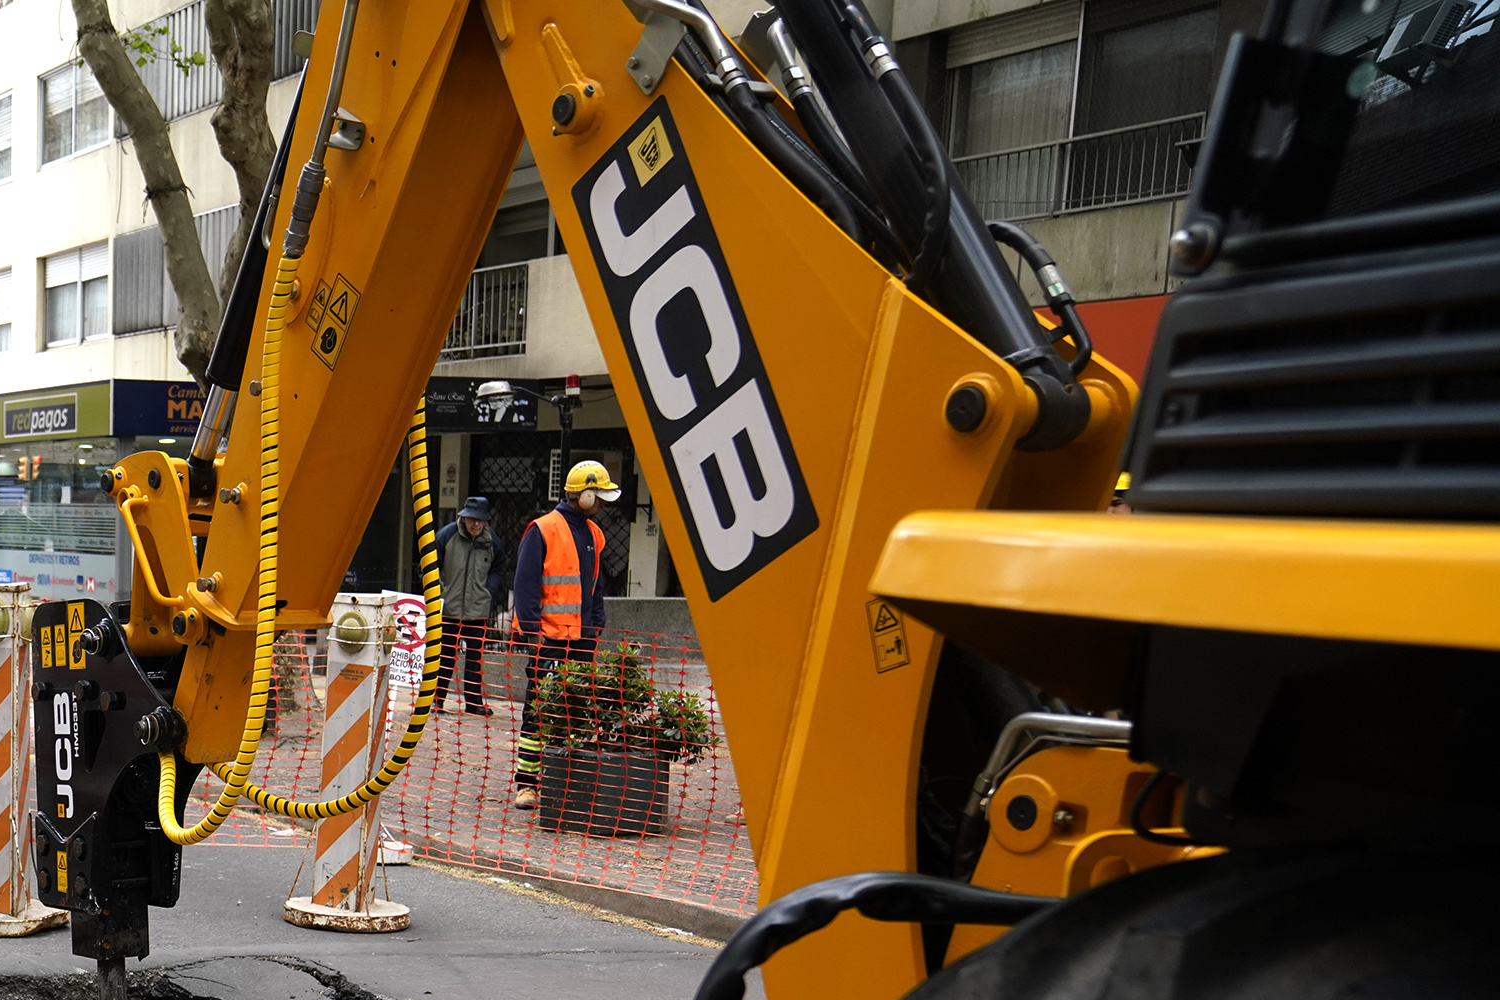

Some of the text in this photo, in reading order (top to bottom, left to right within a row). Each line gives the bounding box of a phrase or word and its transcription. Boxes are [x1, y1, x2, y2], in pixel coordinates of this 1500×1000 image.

[589, 158, 796, 573] JCB
[11, 407, 69, 435] redpagos
[53, 691, 74, 819] JCB
[71, 691, 80, 758] HM033T
